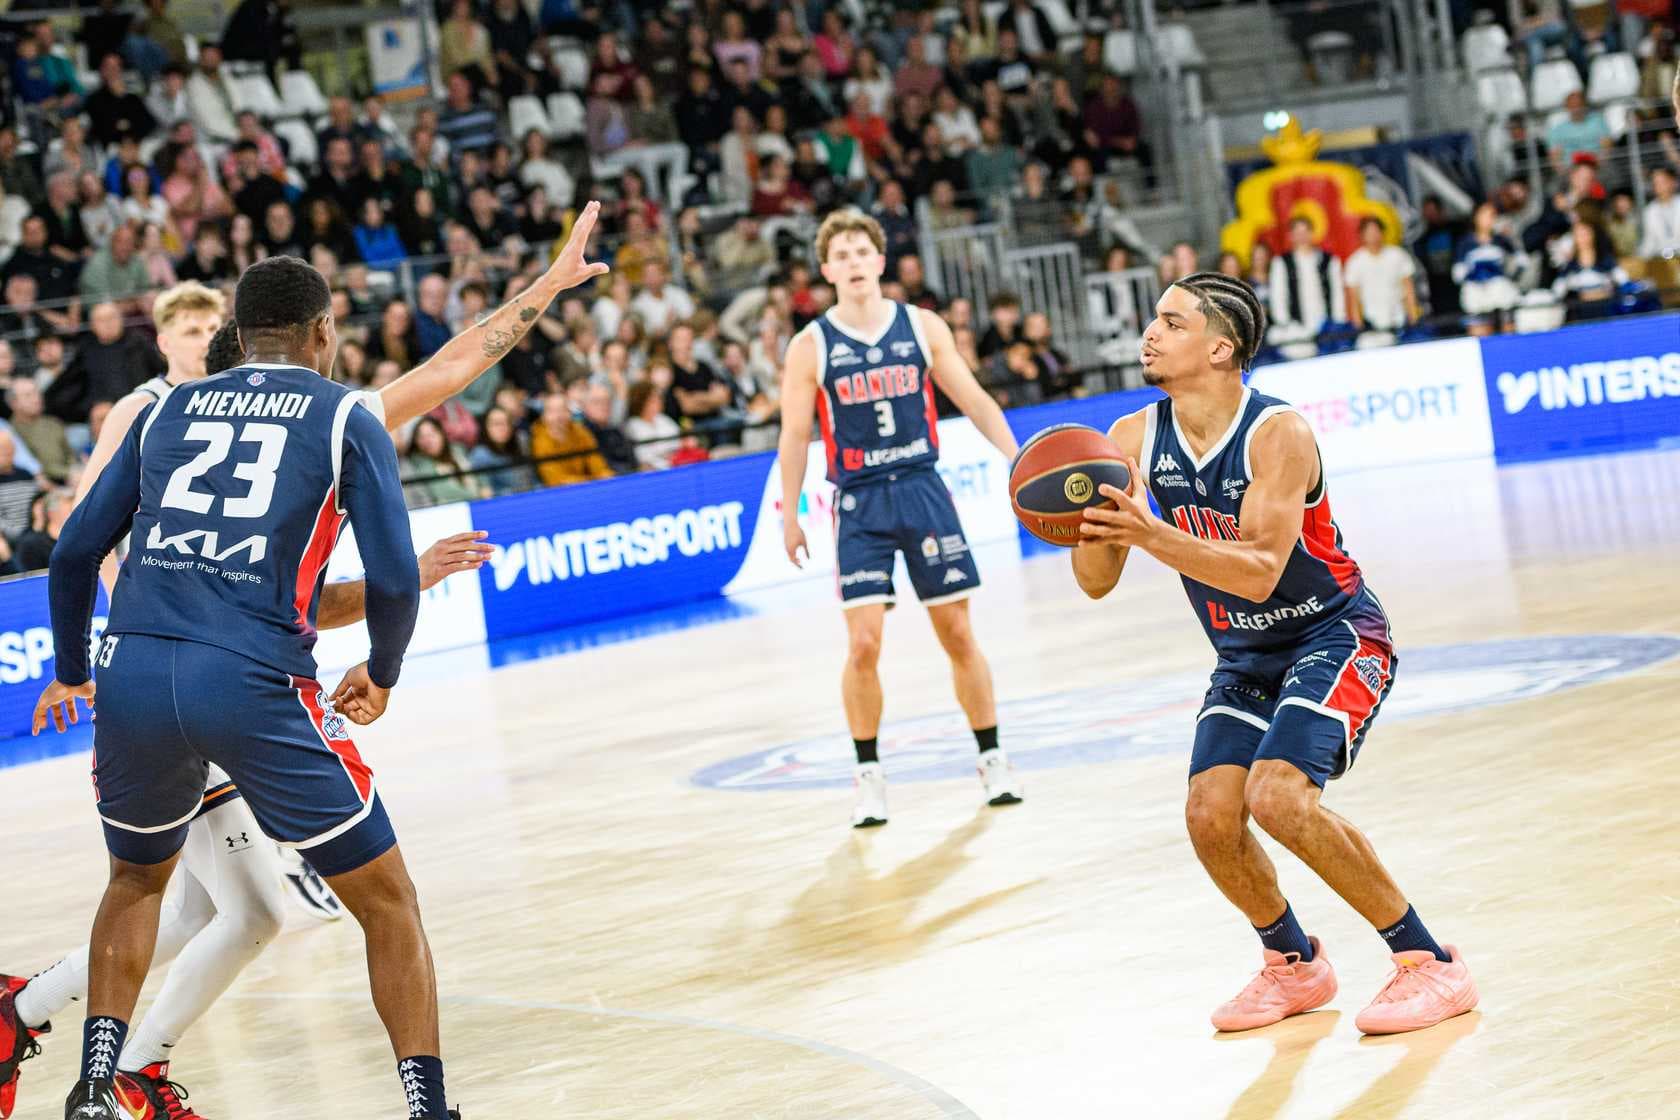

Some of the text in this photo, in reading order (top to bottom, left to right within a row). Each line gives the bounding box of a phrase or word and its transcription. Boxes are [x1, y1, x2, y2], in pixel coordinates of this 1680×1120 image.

[834, 364, 919, 405] NANTES
[184, 390, 314, 419] MIENANDI
[873, 400, 896, 437] 3
[160, 421, 289, 519] 23
[1171, 504, 1242, 541] NANTE
[525, 501, 744, 585] INTERSPORT
[141, 555, 262, 585] Movement that inspires
